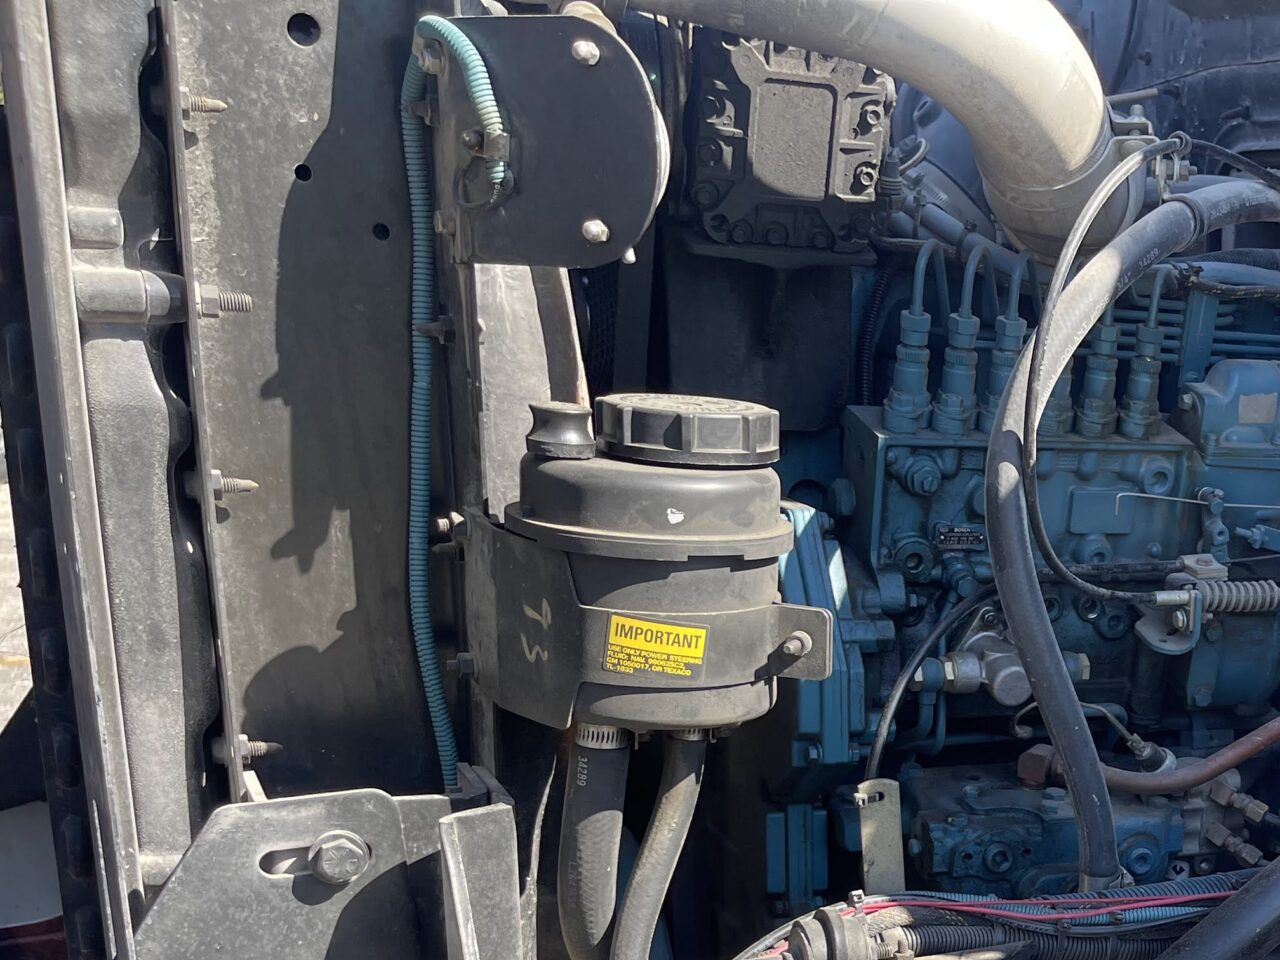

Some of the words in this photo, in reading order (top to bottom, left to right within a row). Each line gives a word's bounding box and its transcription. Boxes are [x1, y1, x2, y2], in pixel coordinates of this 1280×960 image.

[614, 622, 702, 650] IMPORTANT
[607, 651, 629, 661] FLUID:
[608, 644, 621, 652] USE
[622, 647, 640, 656] ONLY
[641, 649, 668, 661] POWER
[669, 654, 703, 665] STEERING
[606, 657, 618, 665] GM
[652, 665, 663, 673] OR
[663, 666, 692, 677] TEXACO
[576, 755, 588, 787] 34289
